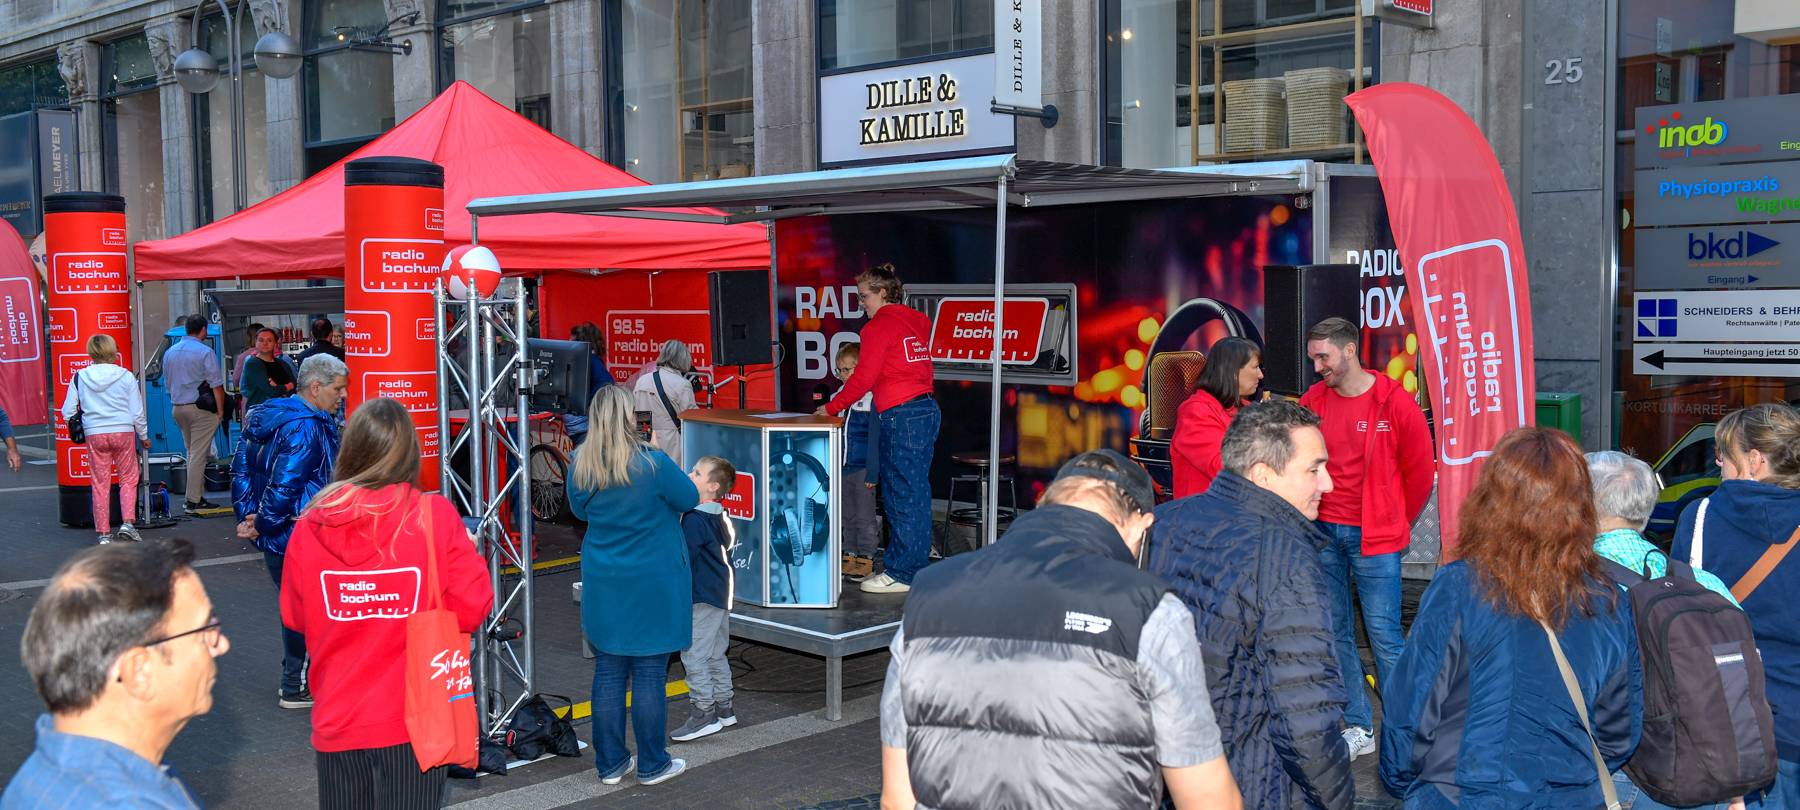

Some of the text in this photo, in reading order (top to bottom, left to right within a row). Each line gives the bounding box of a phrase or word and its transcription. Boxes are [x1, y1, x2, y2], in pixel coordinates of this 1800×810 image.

[1013, 17, 1022, 33] &
[1013, 39, 1023, 94] DILLE
[1544, 57, 1584, 85] 25
[866, 73, 956, 110] DILLE &
[859, 108, 964, 145] KAMILLE
[1659, 175, 1780, 198] Physiopraxis
[1688, 231, 1744, 260] bkd
[382, 249, 425, 260] radio
[68, 260, 104, 268] radio
[382, 262, 440, 273] bochum
[68, 270, 120, 279] bochum
[1707, 275, 1745, 286] Eingang
[795, 286, 866, 319] RAD
[1360, 285, 1405, 328] OX
[1684, 307, 1753, 316] SCHNEIDERS
[1759, 306, 1767, 316] &
[613, 319, 645, 335] 98.5
[1726, 319, 1778, 328] Rechtsanwälte
[953, 326, 1018, 340] bochm
[614, 339, 648, 352] radio
[1703, 348, 1764, 358] Haupteingang
[1766, 348, 1786, 358] jetzt
[379, 379, 412, 388] radio
[379, 389, 428, 398] bochum
[339, 580, 377, 591] radio
[340, 592, 400, 604] bochum
